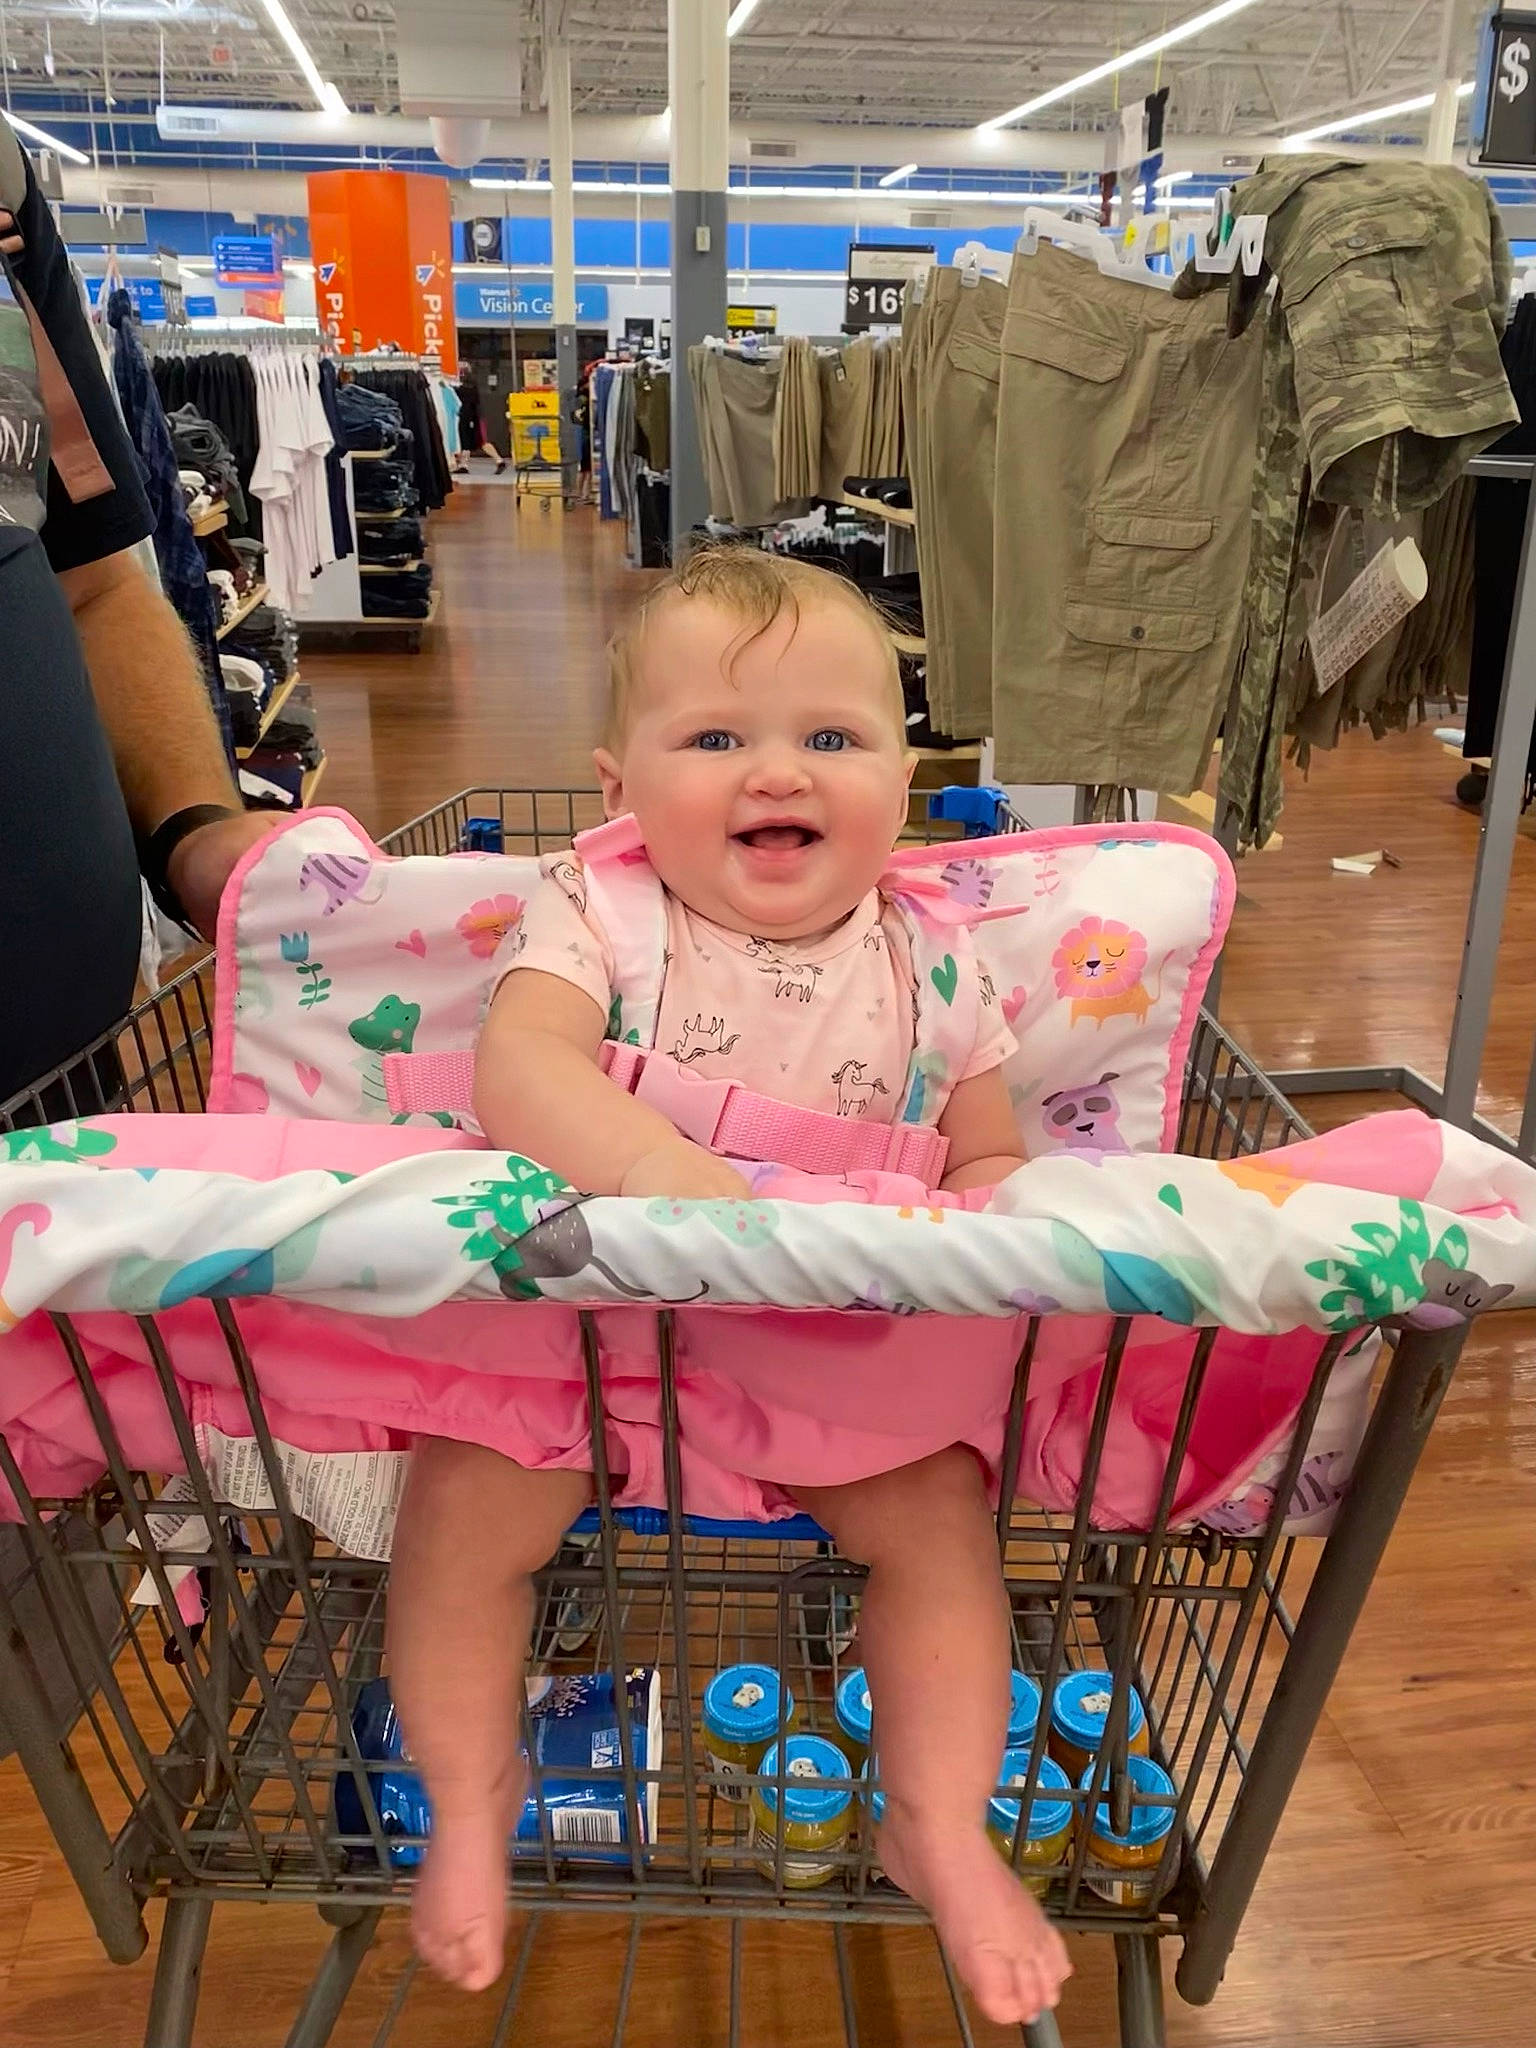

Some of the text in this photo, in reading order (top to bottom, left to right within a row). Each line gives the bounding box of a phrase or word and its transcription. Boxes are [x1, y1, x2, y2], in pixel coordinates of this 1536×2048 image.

[1499, 37, 1531, 103] $
[479, 296, 585, 314] Vision Ceer
[849, 286, 906, 316] $16
